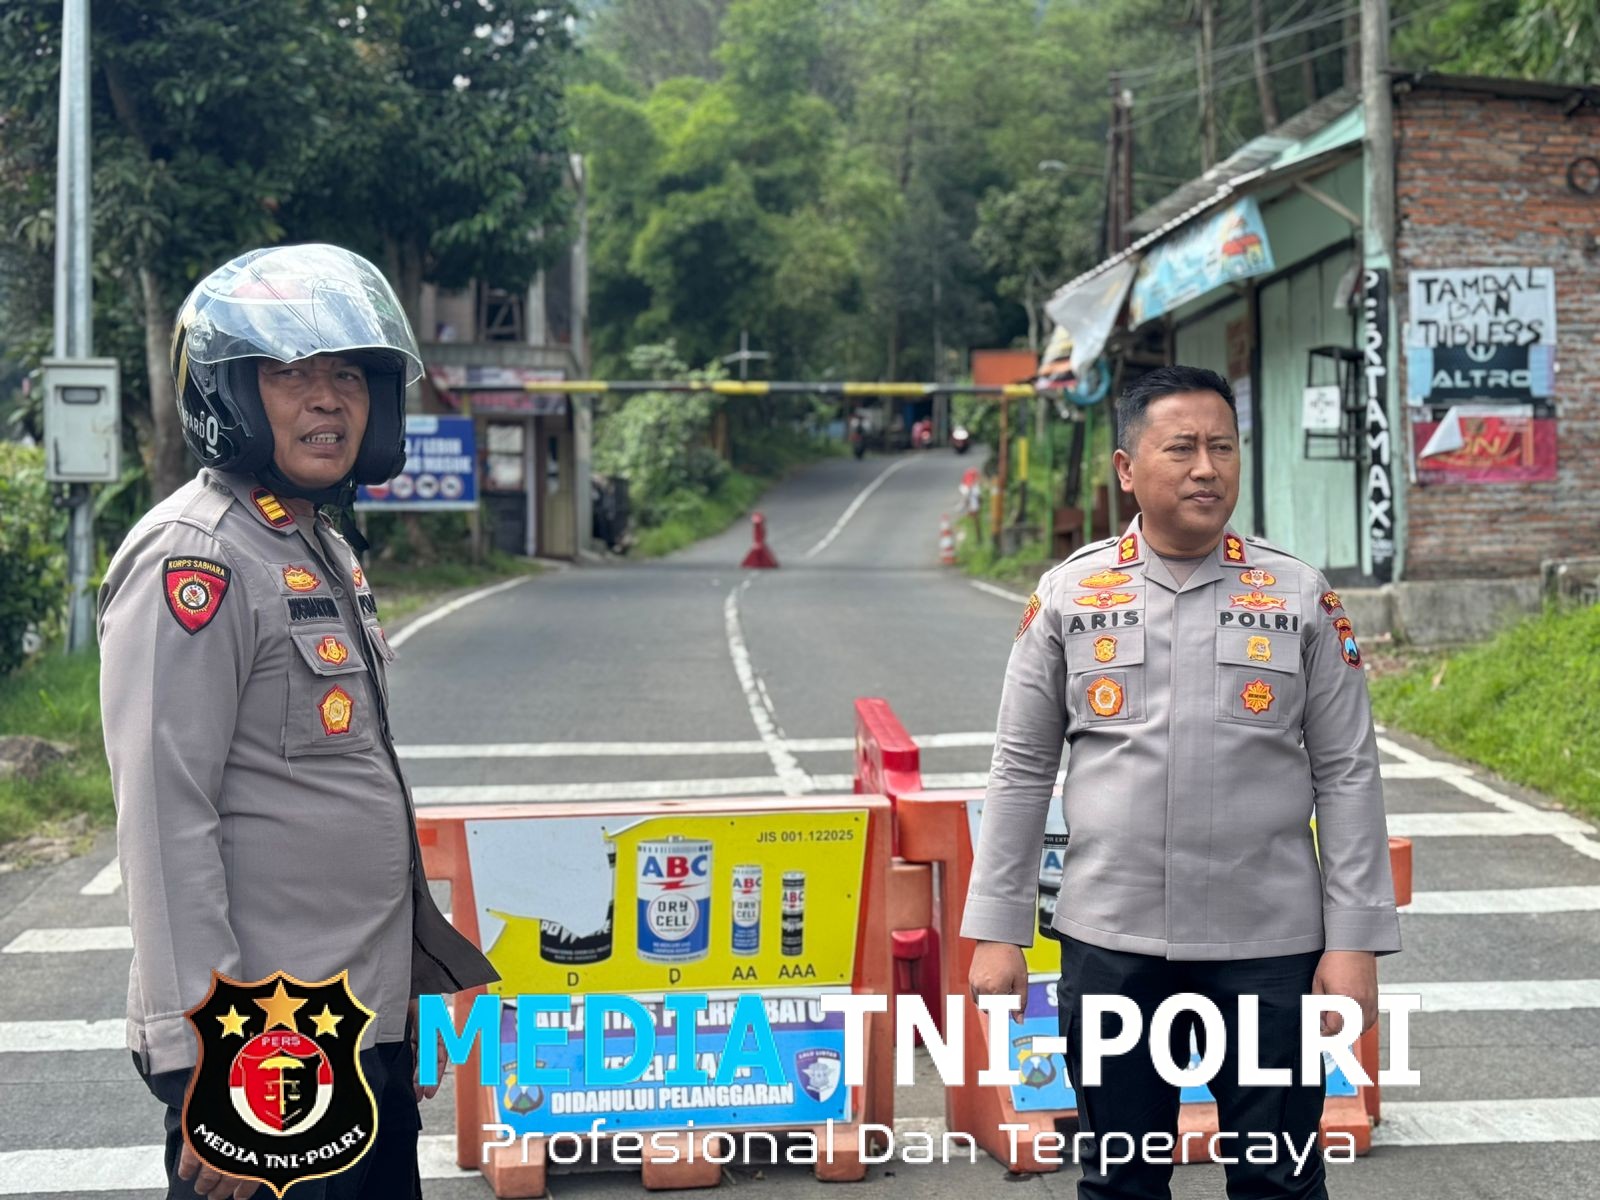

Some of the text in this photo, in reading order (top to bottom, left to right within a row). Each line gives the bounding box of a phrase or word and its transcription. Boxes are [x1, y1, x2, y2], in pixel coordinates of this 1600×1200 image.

[1432, 369, 1532, 388] ALTRO
[168, 560, 225, 577] KORPS SABHARA
[1068, 610, 1140, 633] ARIS
[1219, 611, 1299, 632] POLRI
[756, 830, 854, 843] JIS 001.122025
[641, 855, 708, 879] ABC
[732, 877, 762, 889] ABC
[657, 900, 689, 912] DRY
[782, 891, 804, 903] ABC
[656, 915, 690, 928] CELL
[567, 963, 817, 987] D D AA AAA
[766, 997, 827, 1024] BATU
[551, 1082, 794, 1114] DIDAHULUI PELANGGARAN
